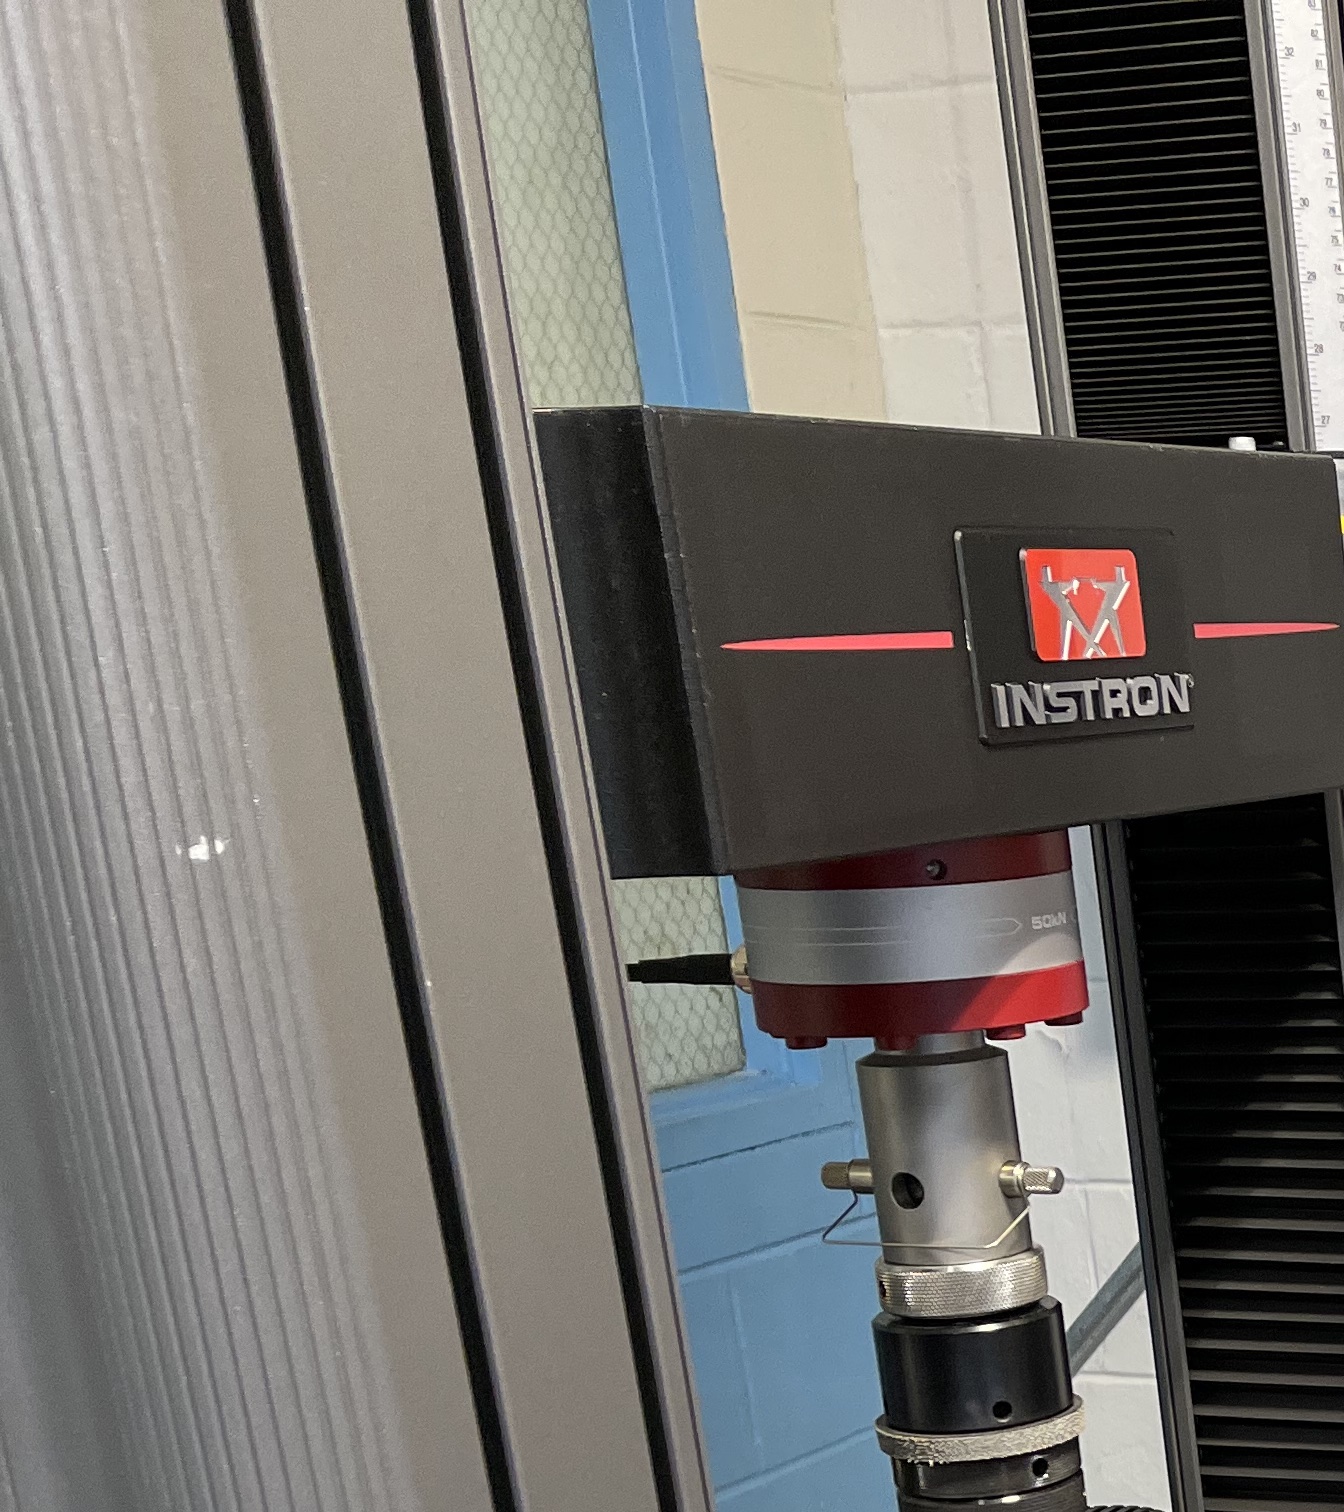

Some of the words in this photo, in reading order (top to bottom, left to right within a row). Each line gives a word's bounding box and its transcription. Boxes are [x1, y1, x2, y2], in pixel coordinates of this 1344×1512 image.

[1285, 46, 1294, 57] 32
[1292, 122, 1301, 132] 31
[1300, 197, 1309, 207] 30
[1307, 271, 1316, 280] 29
[1314, 344, 1324, 353] 28
[1321, 415, 1330, 424] 27
[990, 672, 1191, 728] INSTRON
